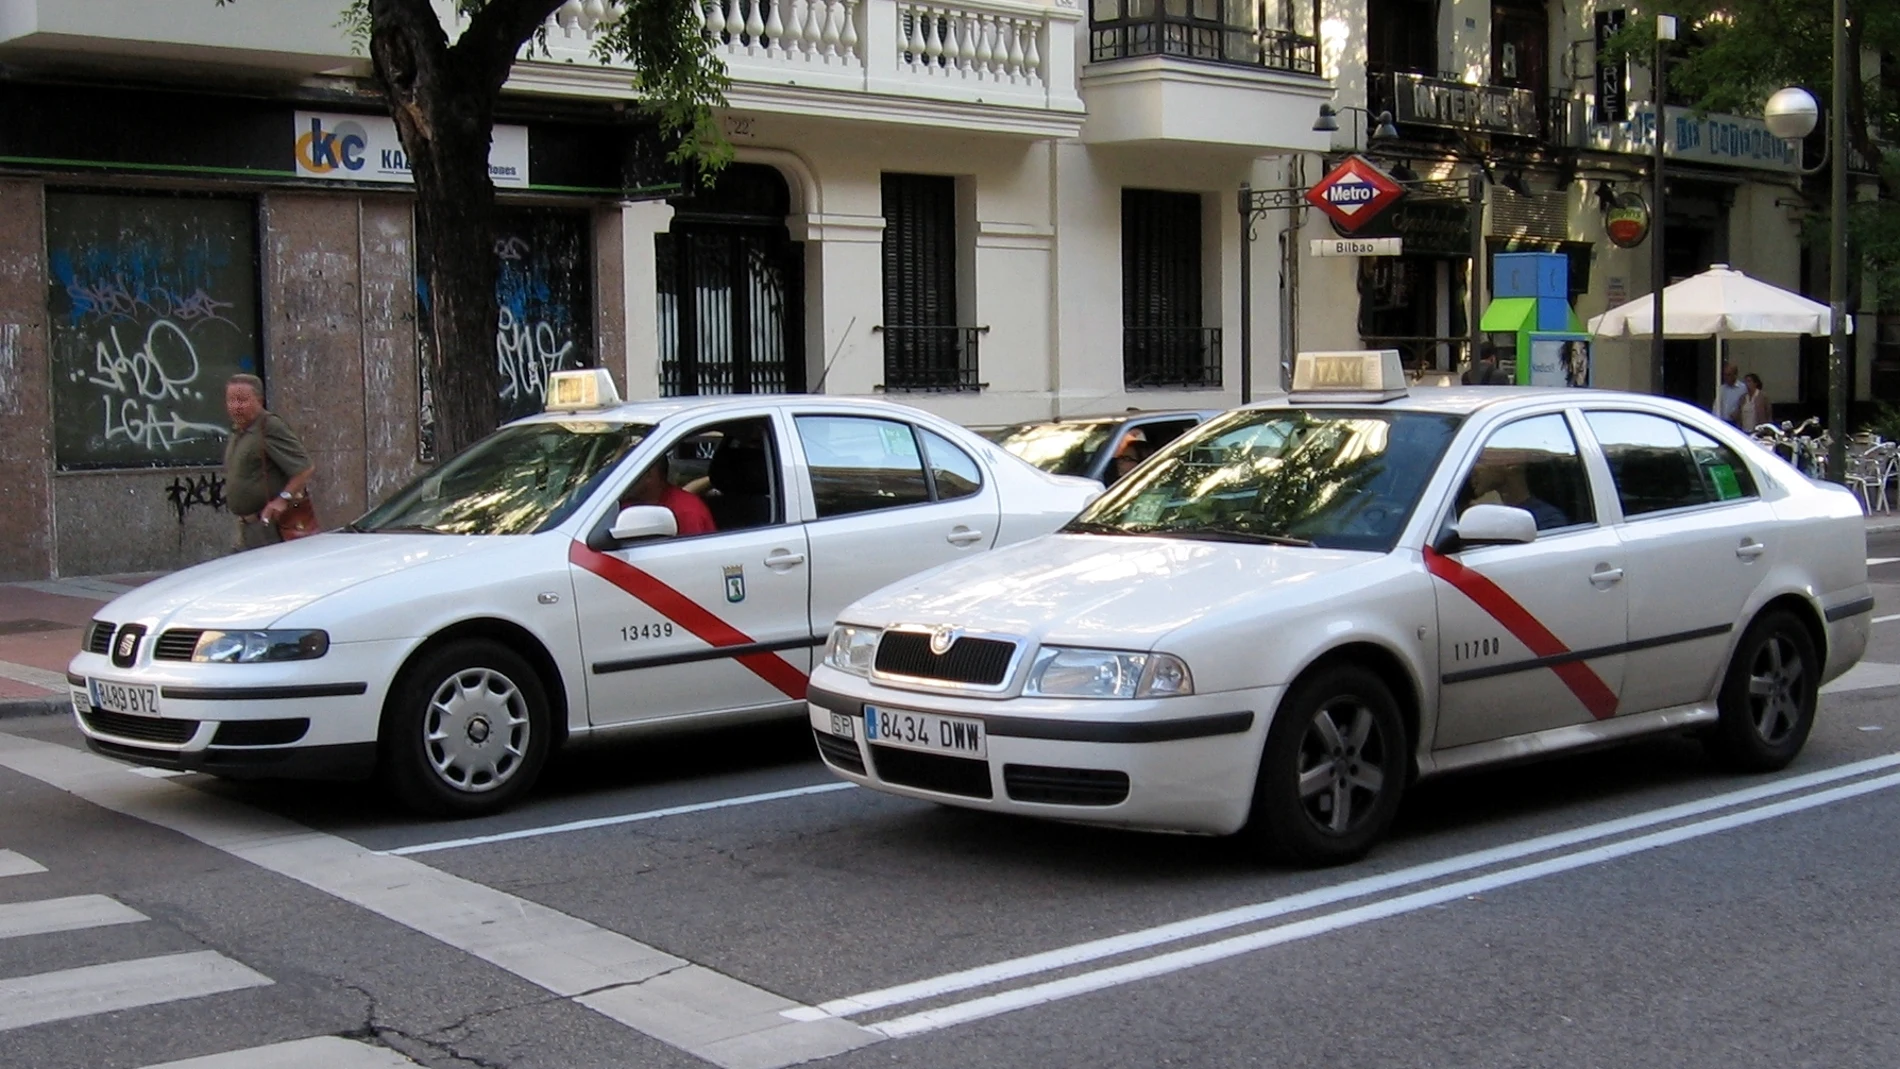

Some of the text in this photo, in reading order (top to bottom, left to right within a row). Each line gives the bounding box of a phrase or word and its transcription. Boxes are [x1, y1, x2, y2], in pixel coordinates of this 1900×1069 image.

[1602, 10, 1618, 122] INRNET
[489, 163, 517, 176] iones
[1330, 186, 1371, 202] Metro
[1336, 242, 1374, 253] Bilbao
[1316, 361, 1361, 382] TAXI
[620, 622, 673, 641] 13439
[1455, 637, 1499, 661] 11700
[128, 687, 157, 713] BYZ
[832, 714, 850, 735] SP
[880, 712, 979, 751] 8434 DWW
